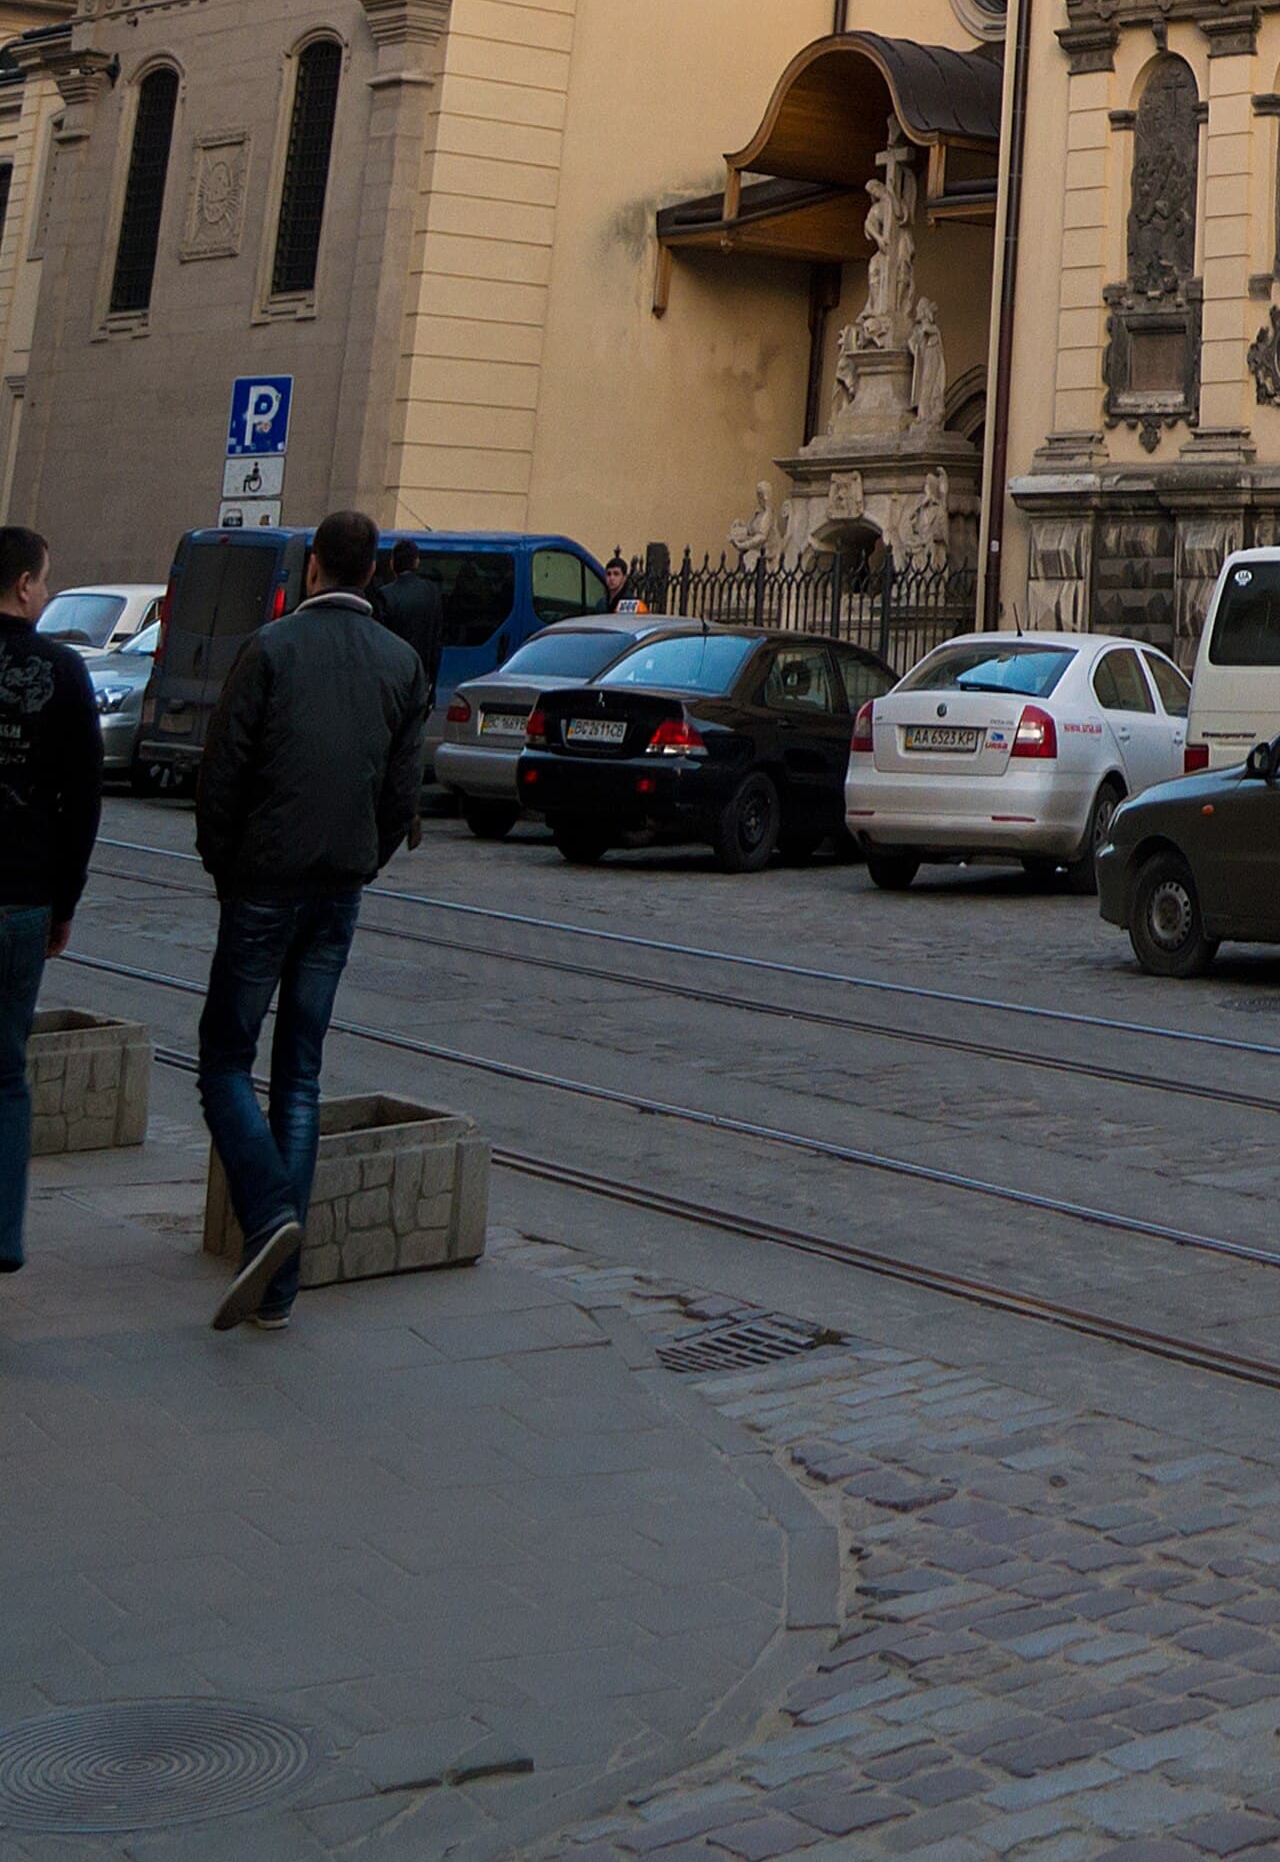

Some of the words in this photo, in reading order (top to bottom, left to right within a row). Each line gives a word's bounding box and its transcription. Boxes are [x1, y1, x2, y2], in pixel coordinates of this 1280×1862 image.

[244, 385, 281, 446] P
[913, 729, 929, 745] AA
[931, 730, 956, 746] 6523
[957, 731, 975, 746] KP
